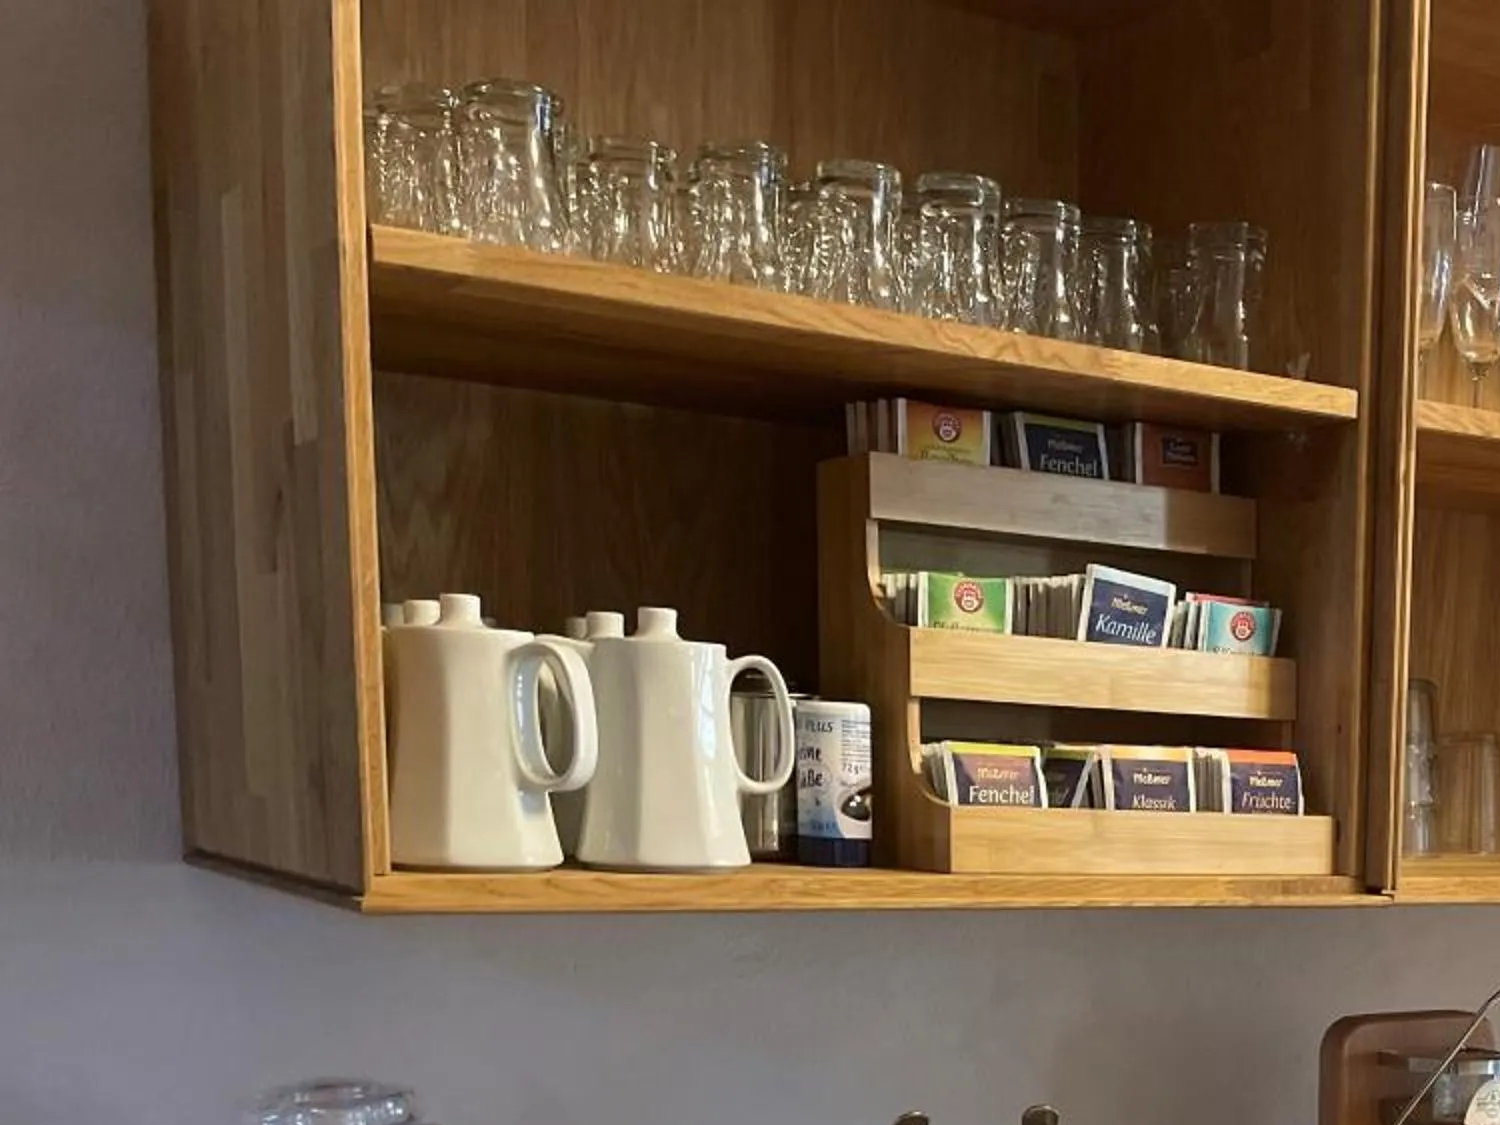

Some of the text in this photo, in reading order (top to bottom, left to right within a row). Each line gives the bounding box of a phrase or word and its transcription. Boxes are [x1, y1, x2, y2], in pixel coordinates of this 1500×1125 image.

[1040, 453, 1098, 477] Fenchel
[1096, 613, 1157, 645] Kamille
[969, 785, 1035, 805] Fenchel
[1132, 794, 1177, 810] Klassik
